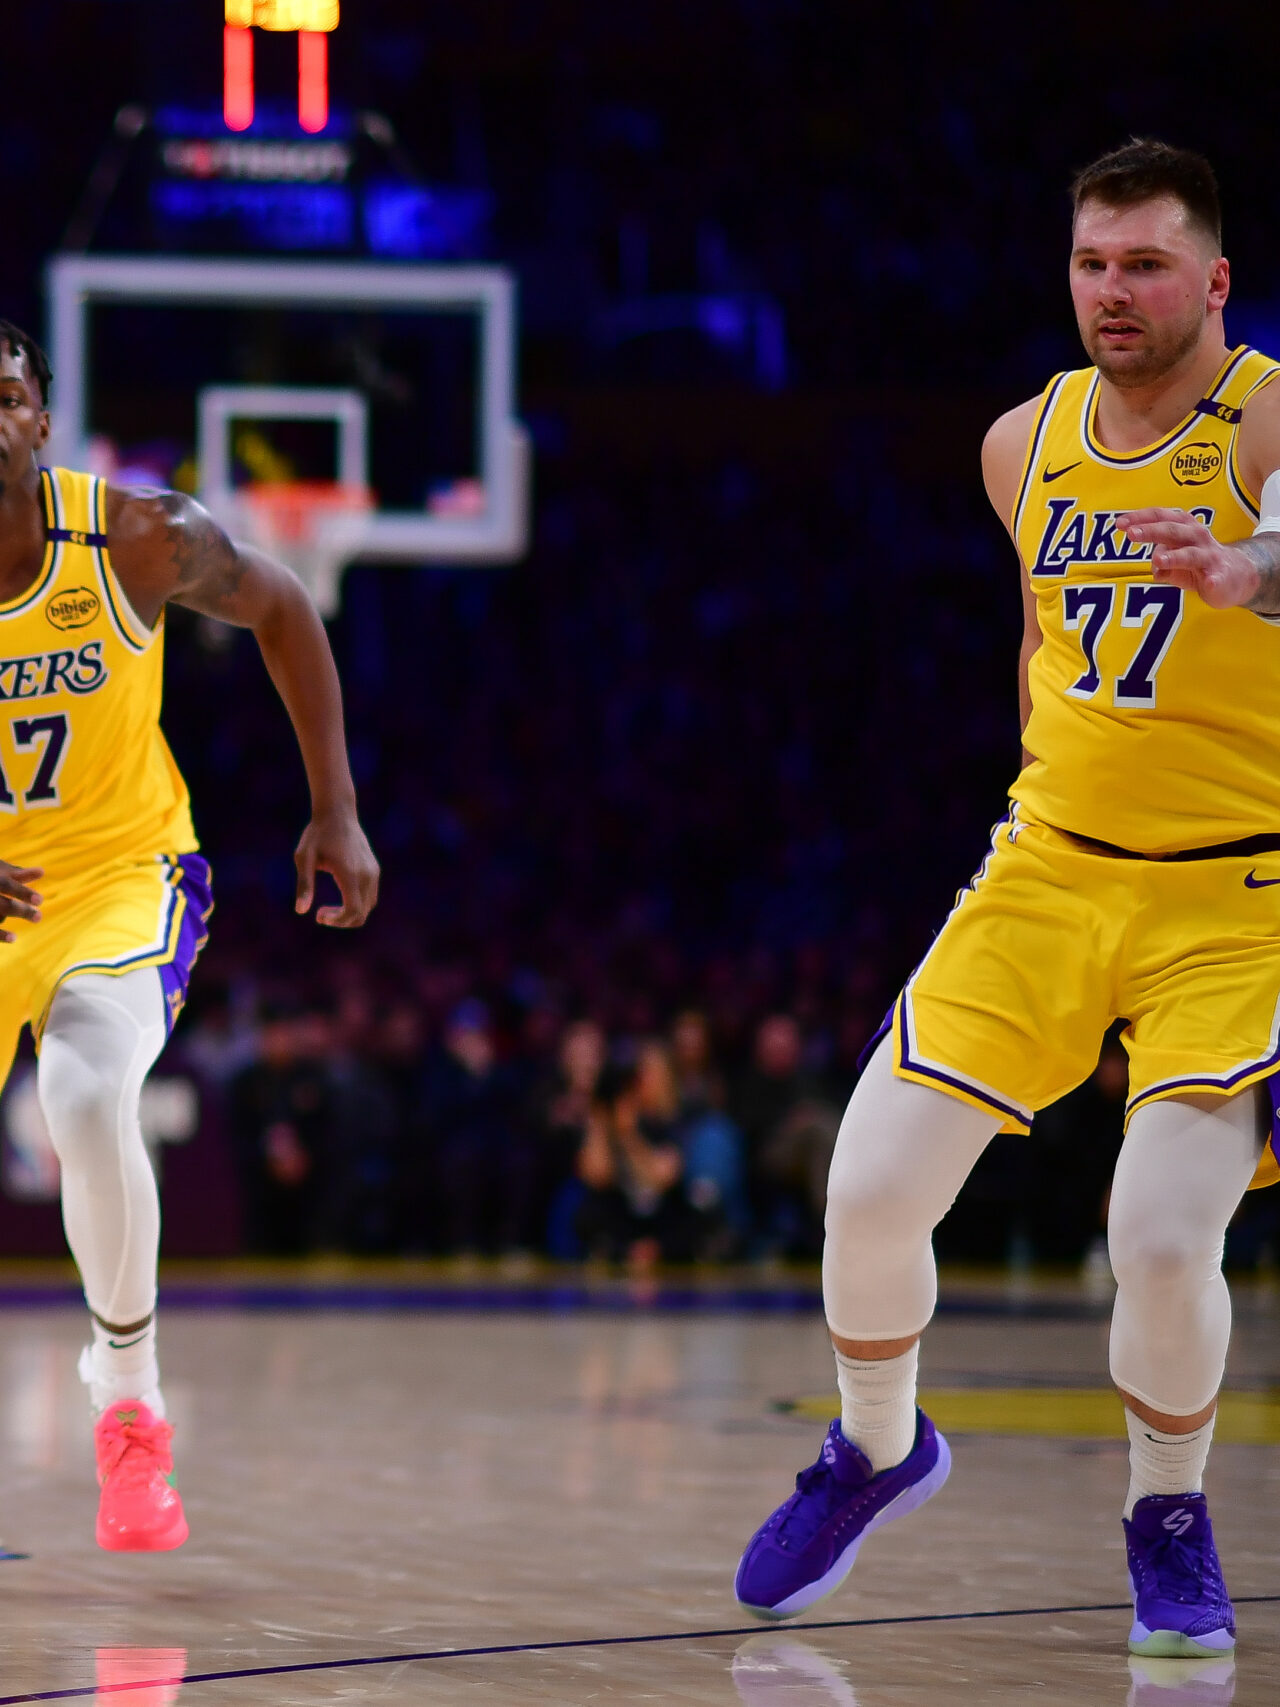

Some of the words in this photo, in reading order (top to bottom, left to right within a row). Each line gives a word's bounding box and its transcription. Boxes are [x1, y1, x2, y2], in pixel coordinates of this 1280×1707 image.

[1216, 405, 1234, 421] 44
[1175, 453, 1220, 472] bibigo
[1032, 497, 1216, 577] LAKE
[50, 599, 97, 616] bibigo
[1061, 583, 1184, 708] 77
